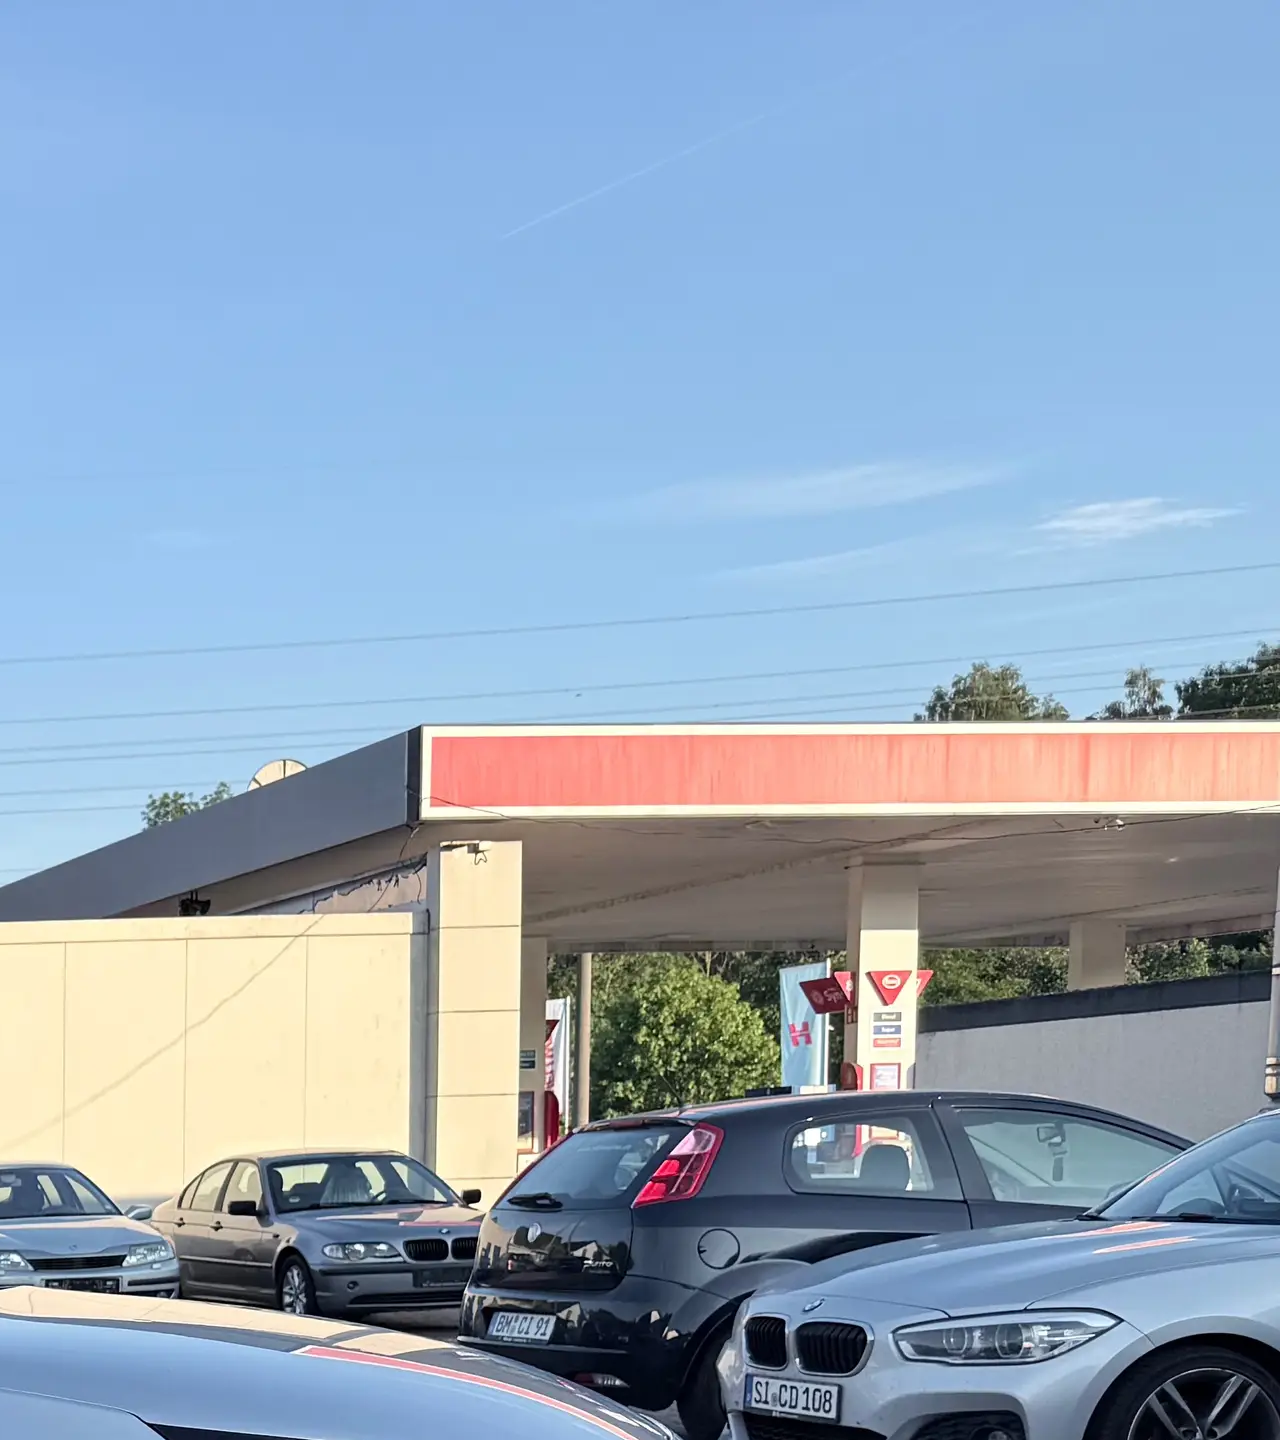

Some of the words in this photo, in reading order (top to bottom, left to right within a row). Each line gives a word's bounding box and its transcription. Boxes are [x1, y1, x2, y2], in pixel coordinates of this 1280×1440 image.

[495, 1314, 514, 1333] BM
[517, 1316, 534, 1335] CI
[534, 1317, 551, 1337] 91
[754, 1380, 770, 1405] SI
[778, 1384, 799, 1409] CD
[801, 1386, 833, 1414] 108
